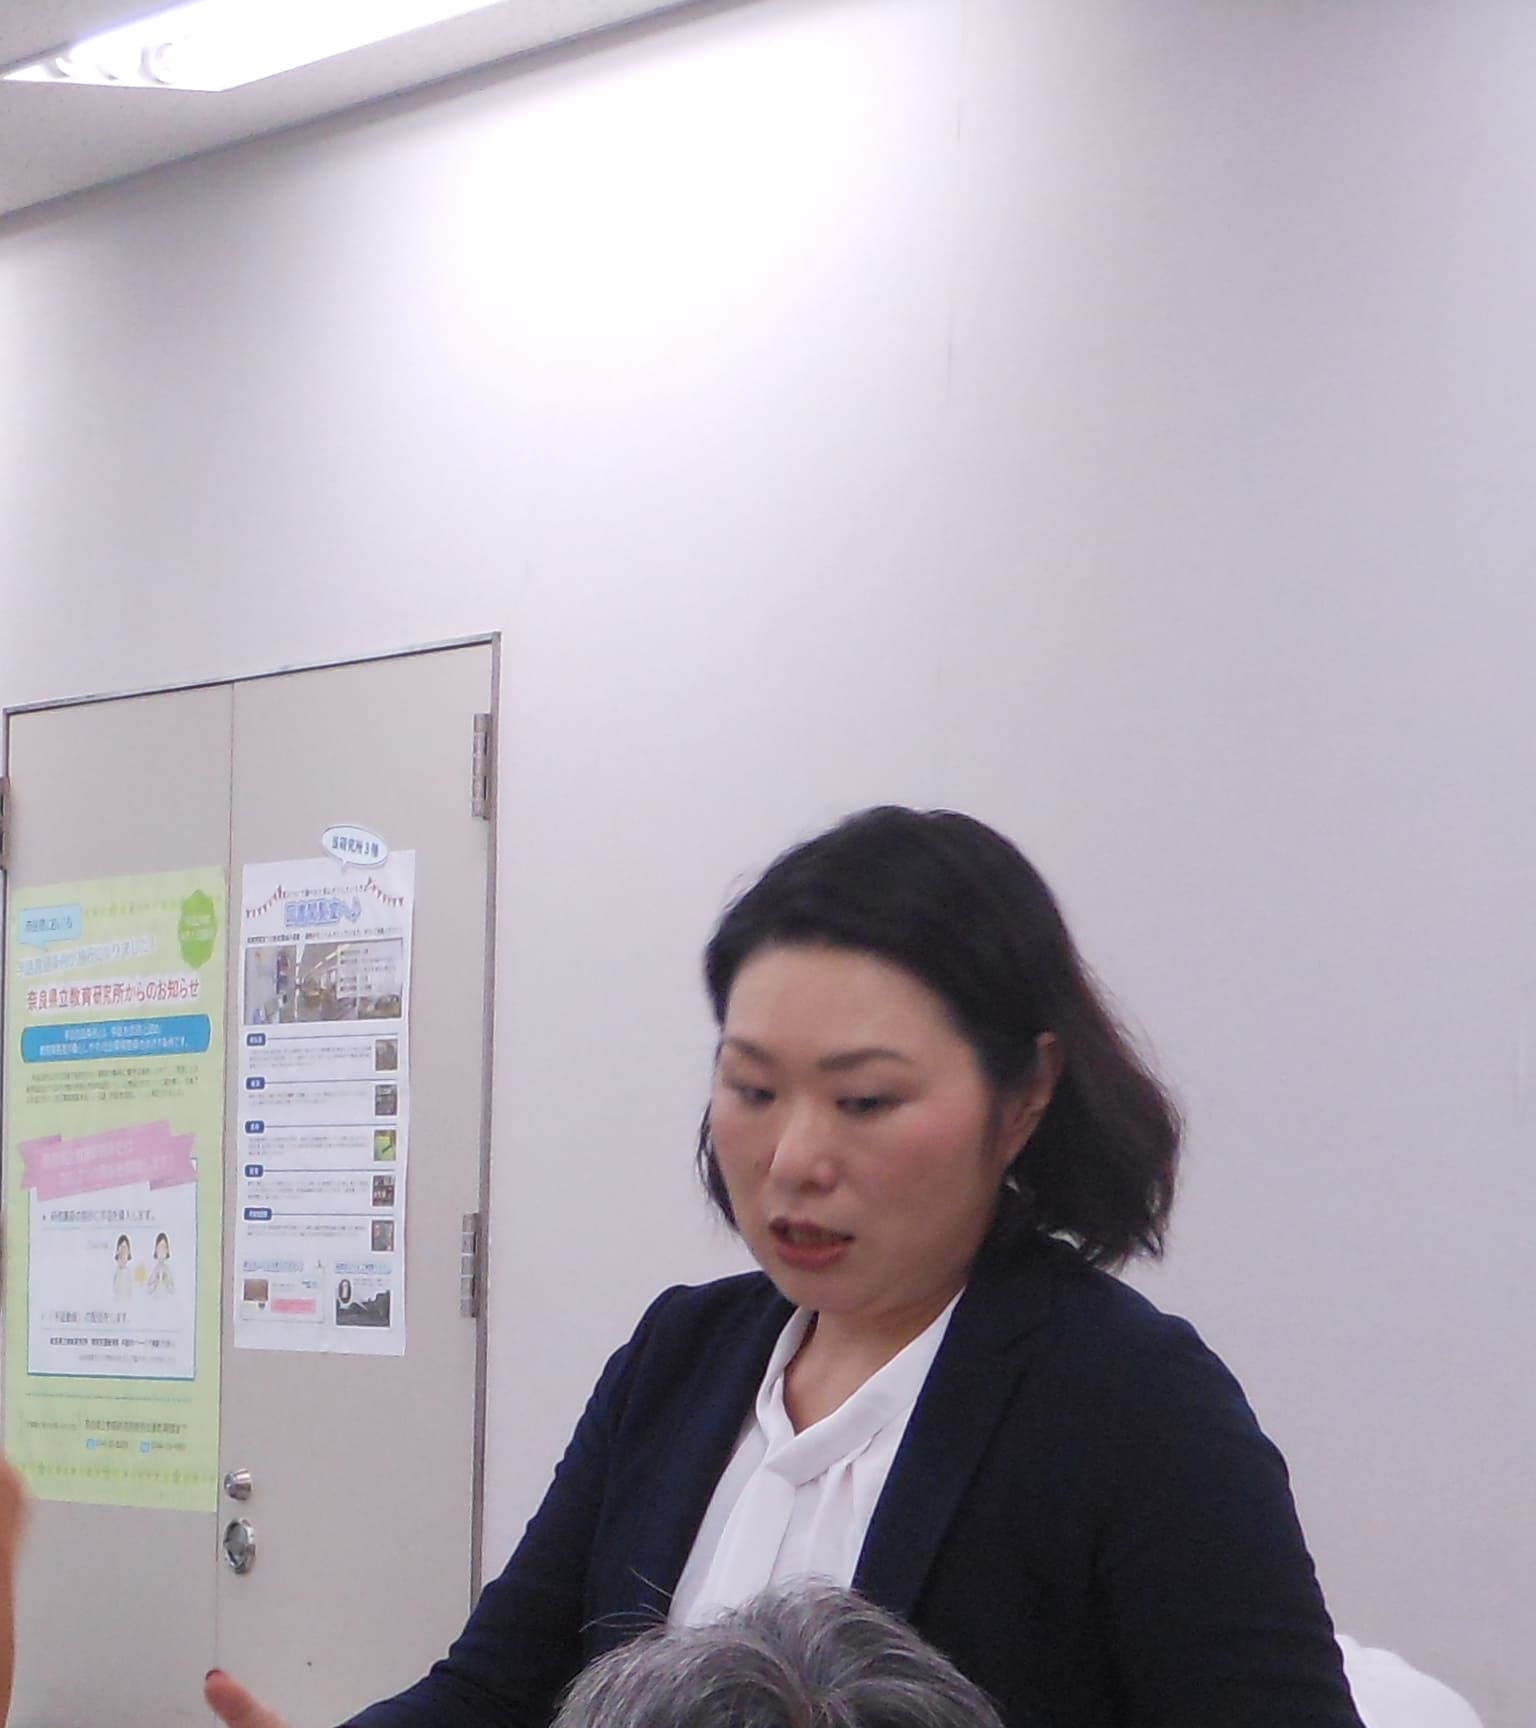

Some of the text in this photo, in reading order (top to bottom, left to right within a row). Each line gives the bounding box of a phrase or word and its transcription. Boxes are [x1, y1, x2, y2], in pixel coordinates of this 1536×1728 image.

[27, 977, 200, 1012] 奈良県立教育研究所からのお知らせ
